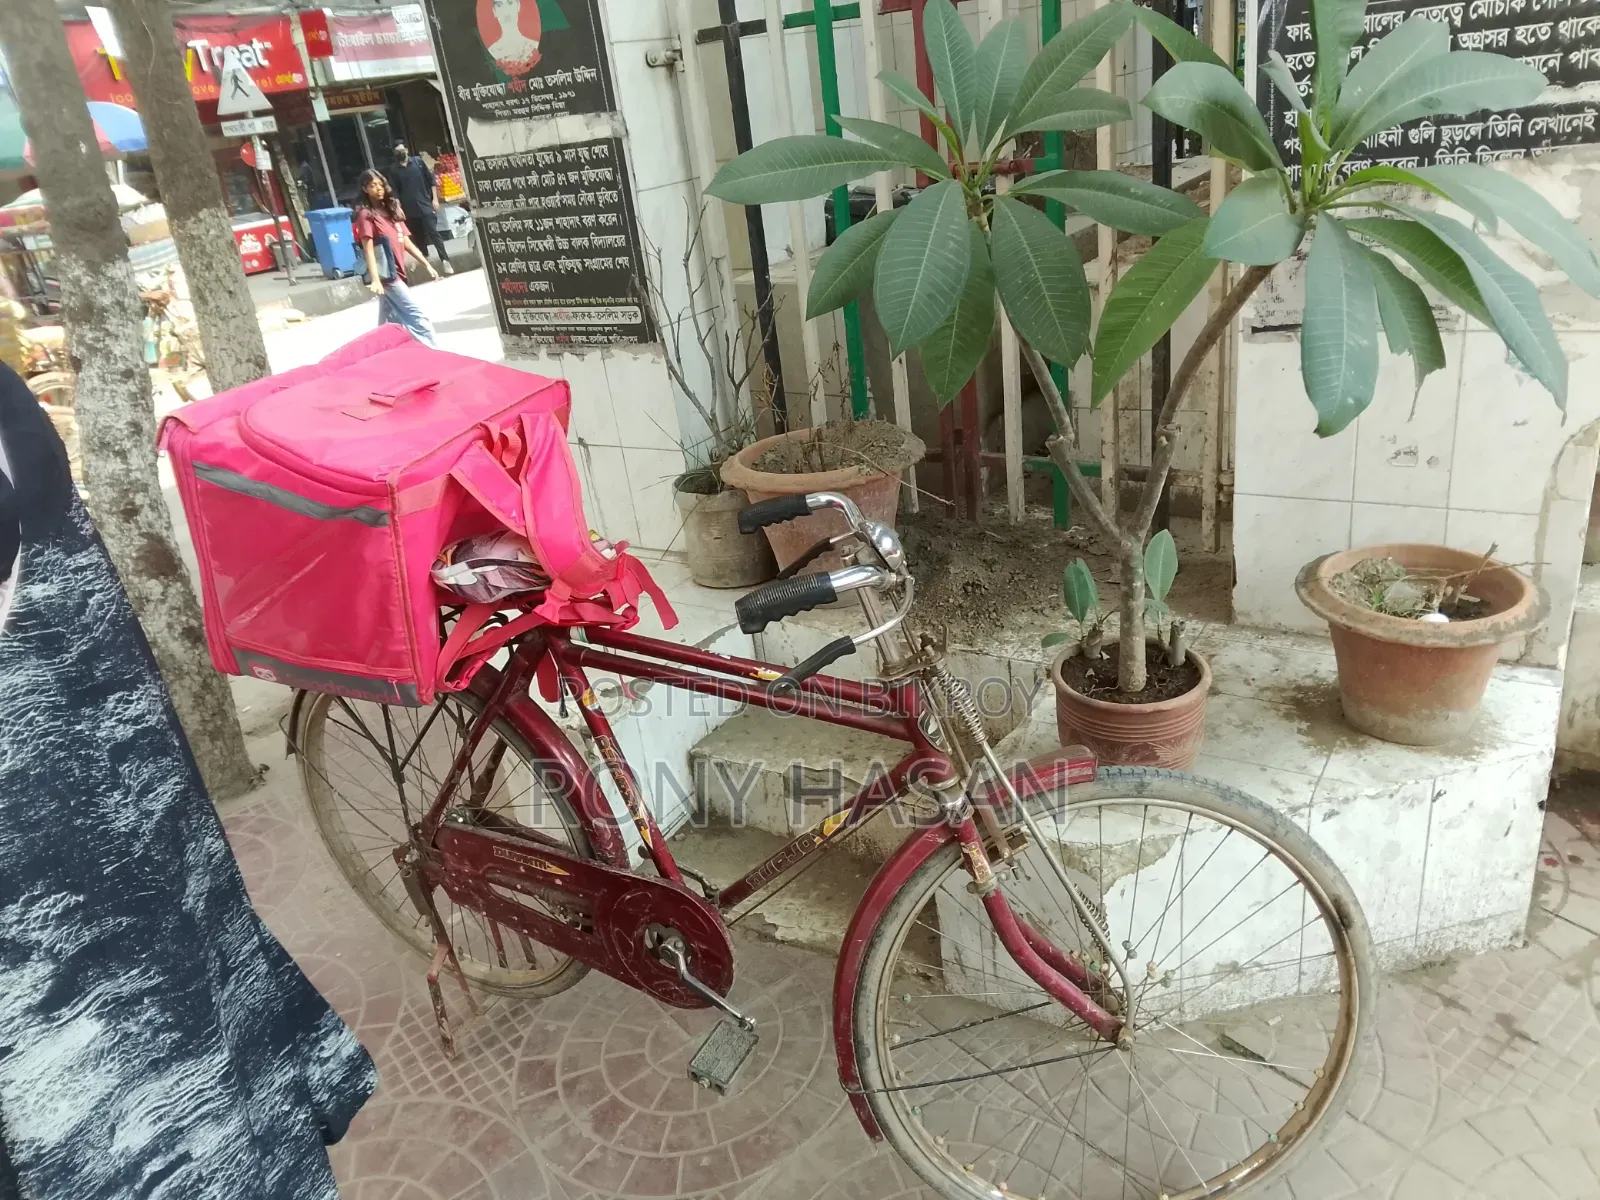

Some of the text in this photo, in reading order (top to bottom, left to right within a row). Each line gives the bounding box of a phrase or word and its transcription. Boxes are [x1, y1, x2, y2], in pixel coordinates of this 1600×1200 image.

[1458, 28, 1510, 51] অগ্রসর
[1514, 22, 1554, 45] হতে
[457, 85, 471, 101] বীর
[544, 70, 572, 87] তসলিম
[1408, 120, 1438, 144] গুলি
[1488, 113, 1524, 138] তিনি
[1528, 106, 1599, 137] সেখানেই
[500, 216, 522, 232] তসলিম
[491, 238, 507, 254] তিনি
